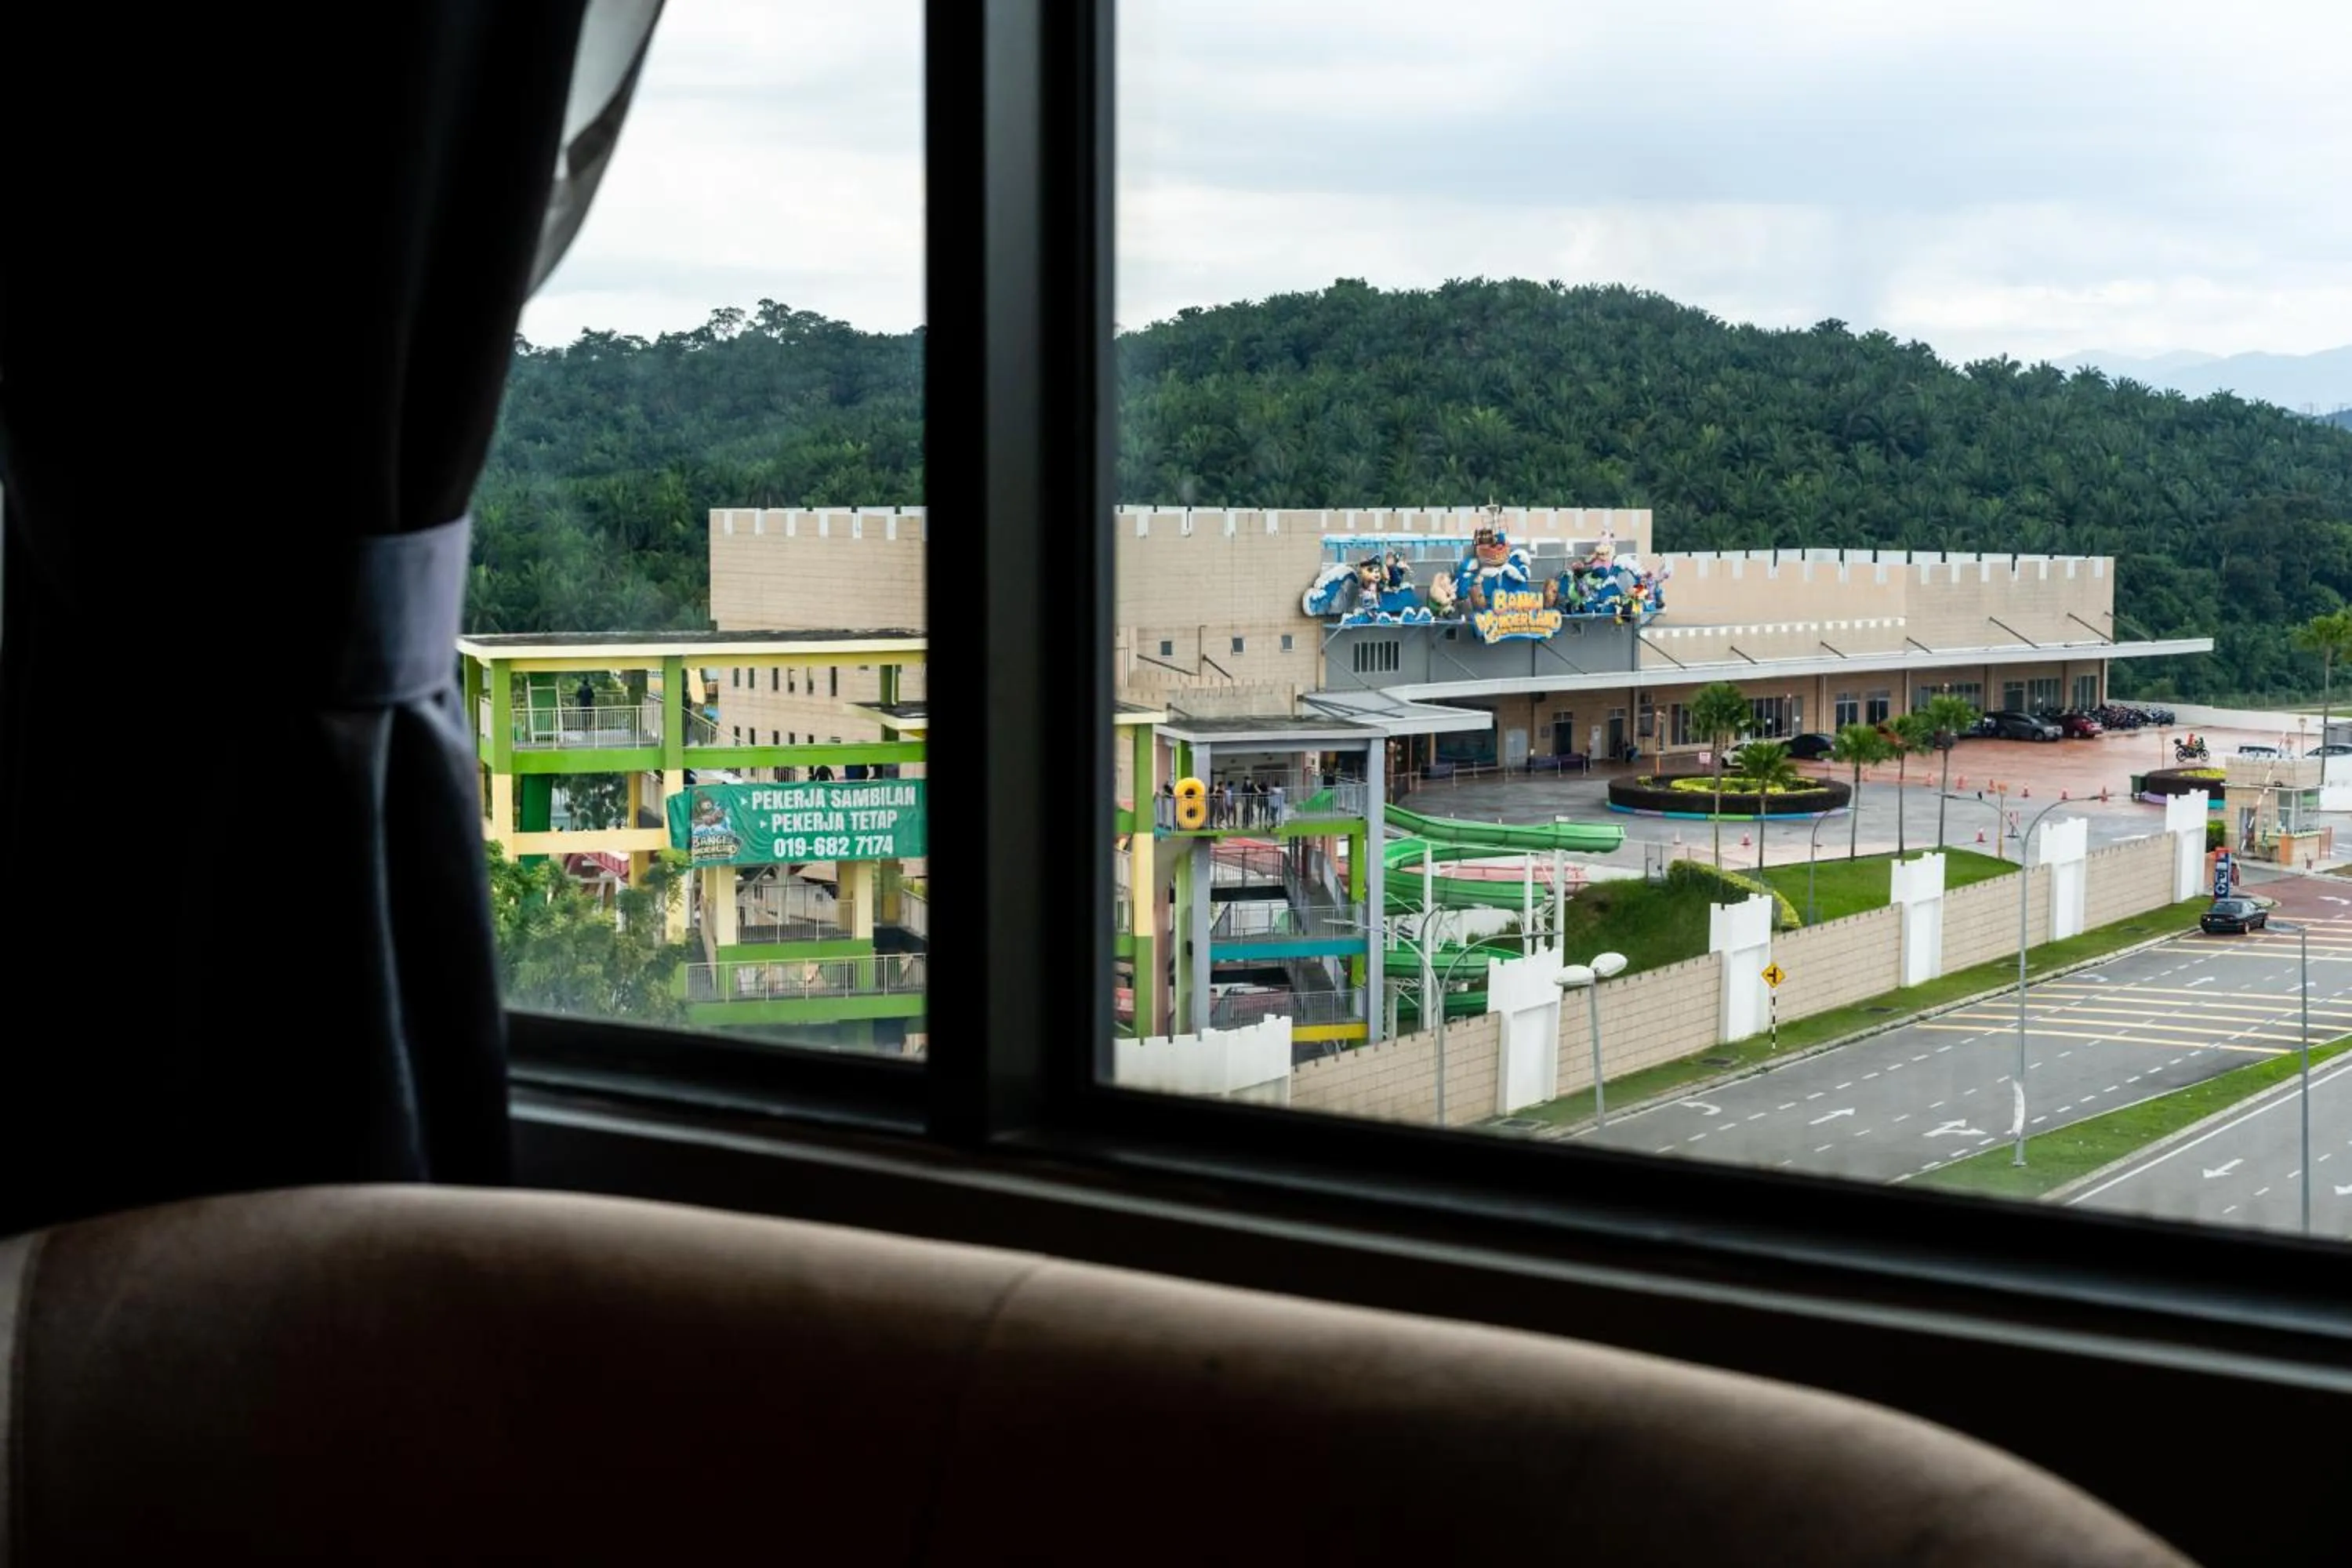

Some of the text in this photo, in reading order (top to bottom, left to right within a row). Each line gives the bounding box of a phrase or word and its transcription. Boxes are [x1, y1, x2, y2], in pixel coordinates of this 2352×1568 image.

[752, 786, 916, 810] PEKERJA SAMBILAN
[771, 810, 898, 833] PEKERJA TETAP
[773, 835, 894, 858] 019-682 7174
